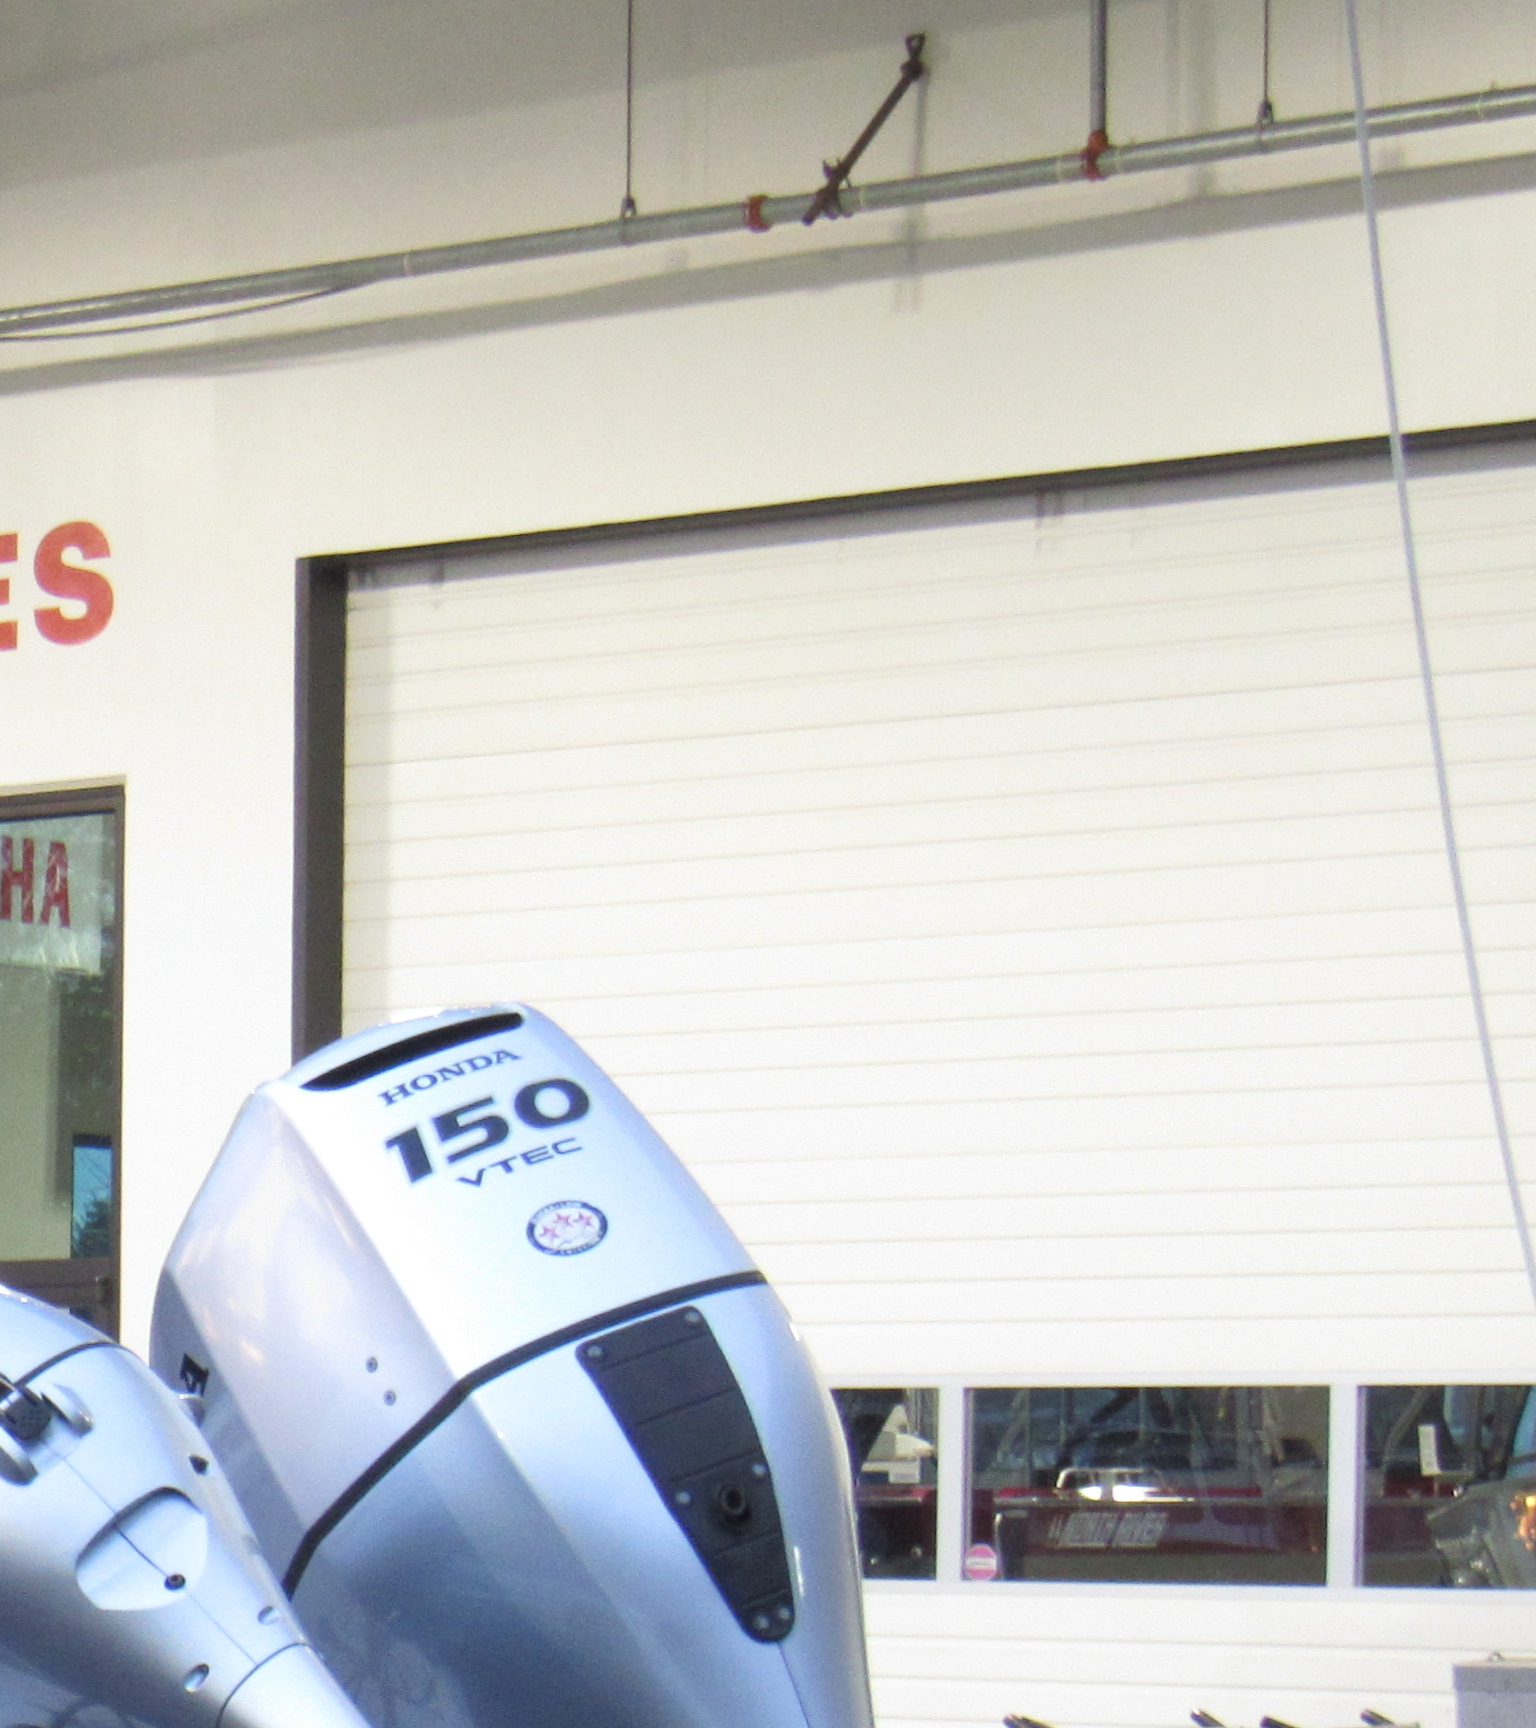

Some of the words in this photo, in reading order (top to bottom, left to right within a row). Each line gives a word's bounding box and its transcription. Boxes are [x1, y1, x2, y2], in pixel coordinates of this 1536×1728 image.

[378, 1047, 524, 1107] HONDA
[385, 1077, 590, 1185] 150
[456, 1136, 584, 1188] VTEC
